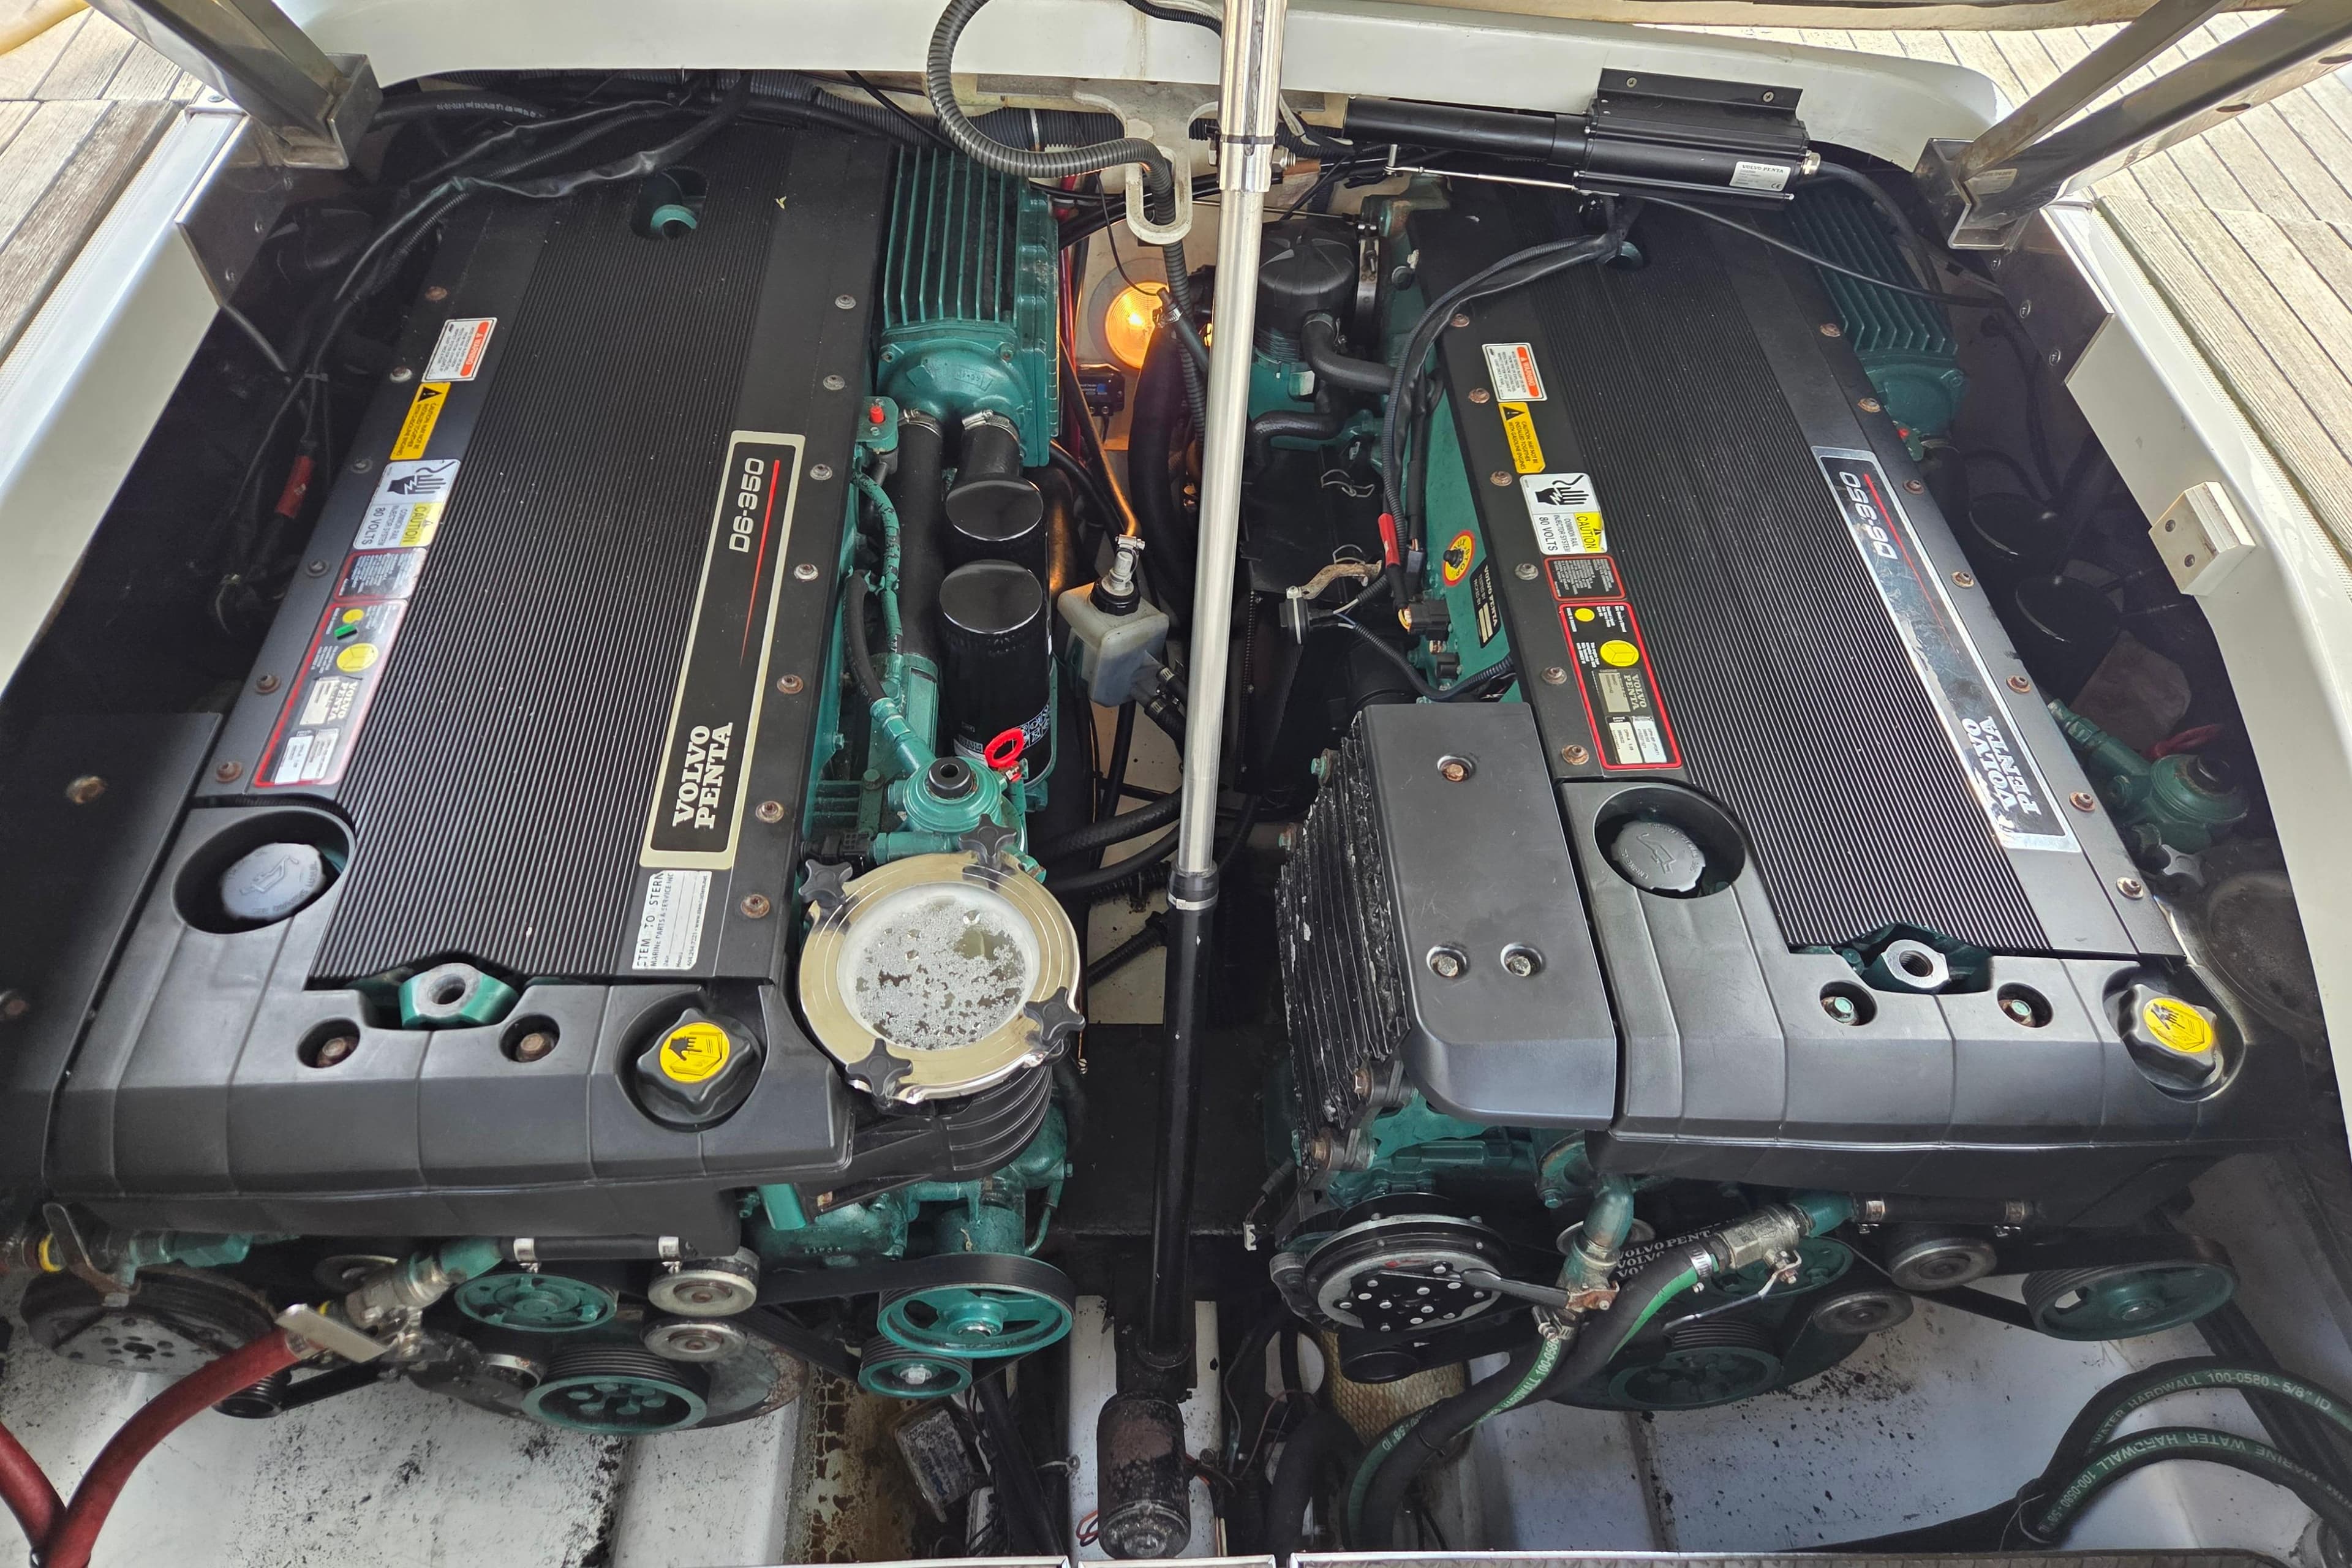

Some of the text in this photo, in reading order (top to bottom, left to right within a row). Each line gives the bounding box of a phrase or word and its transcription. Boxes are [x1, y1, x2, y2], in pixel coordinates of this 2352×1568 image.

[1521, 361, 1536, 386] WARNING
[729, 458, 764, 552] D6-350
[1839, 472, 1898, 560] D6-350
[360, 507, 386, 545] 80 VOLTS
[402, 506, 428, 543] CAUTION
[1538, 516, 1559, 551] 80 VOLTS
[1553, 514, 1571, 552] INJECTOR SYSTEM
[1563, 518, 1579, 547] COMMON RAIL
[1575, 516, 1597, 549] CAUTION
[1456, 548, 1469, 576] STOP
[1483, 564, 1498, 627] VOLVO PENTA
[326, 682, 350, 721] PENTA
[336, 682, 358, 718] VOLVO
[1622, 674, 1640, 710] PENTA
[1630, 674, 1648, 707] VOLVO
[672, 725, 710, 827] VOLVO
[694, 722, 733, 829] PENTA
[1962, 718, 2018, 812] VOLVO
[1980, 716, 2041, 815] PENTA
[648, 872, 664, 905] STERN
[644, 914, 655, 929] TO
[655, 918, 665, 938] PARTS
[660, 886, 671, 910] SERVICE
[1666, 1229, 1715, 1248] PENT
[2094, 1409, 2125, 1444] WATER
[2127, 1375, 2202, 1409] HARDWALL
[2207, 1371, 2269, 1387] 100-0580
[2282, 1381, 2313, 1398] 5/8"
[2315, 1395, 2332, 1410] ID
[1382, 1436, 1392, 1451] ID
[2095, 1432, 2180, 1471] HARDWALL
[2185, 1432, 2246, 1452] WATER
[2060, 1470, 2097, 1508] 100-0580
